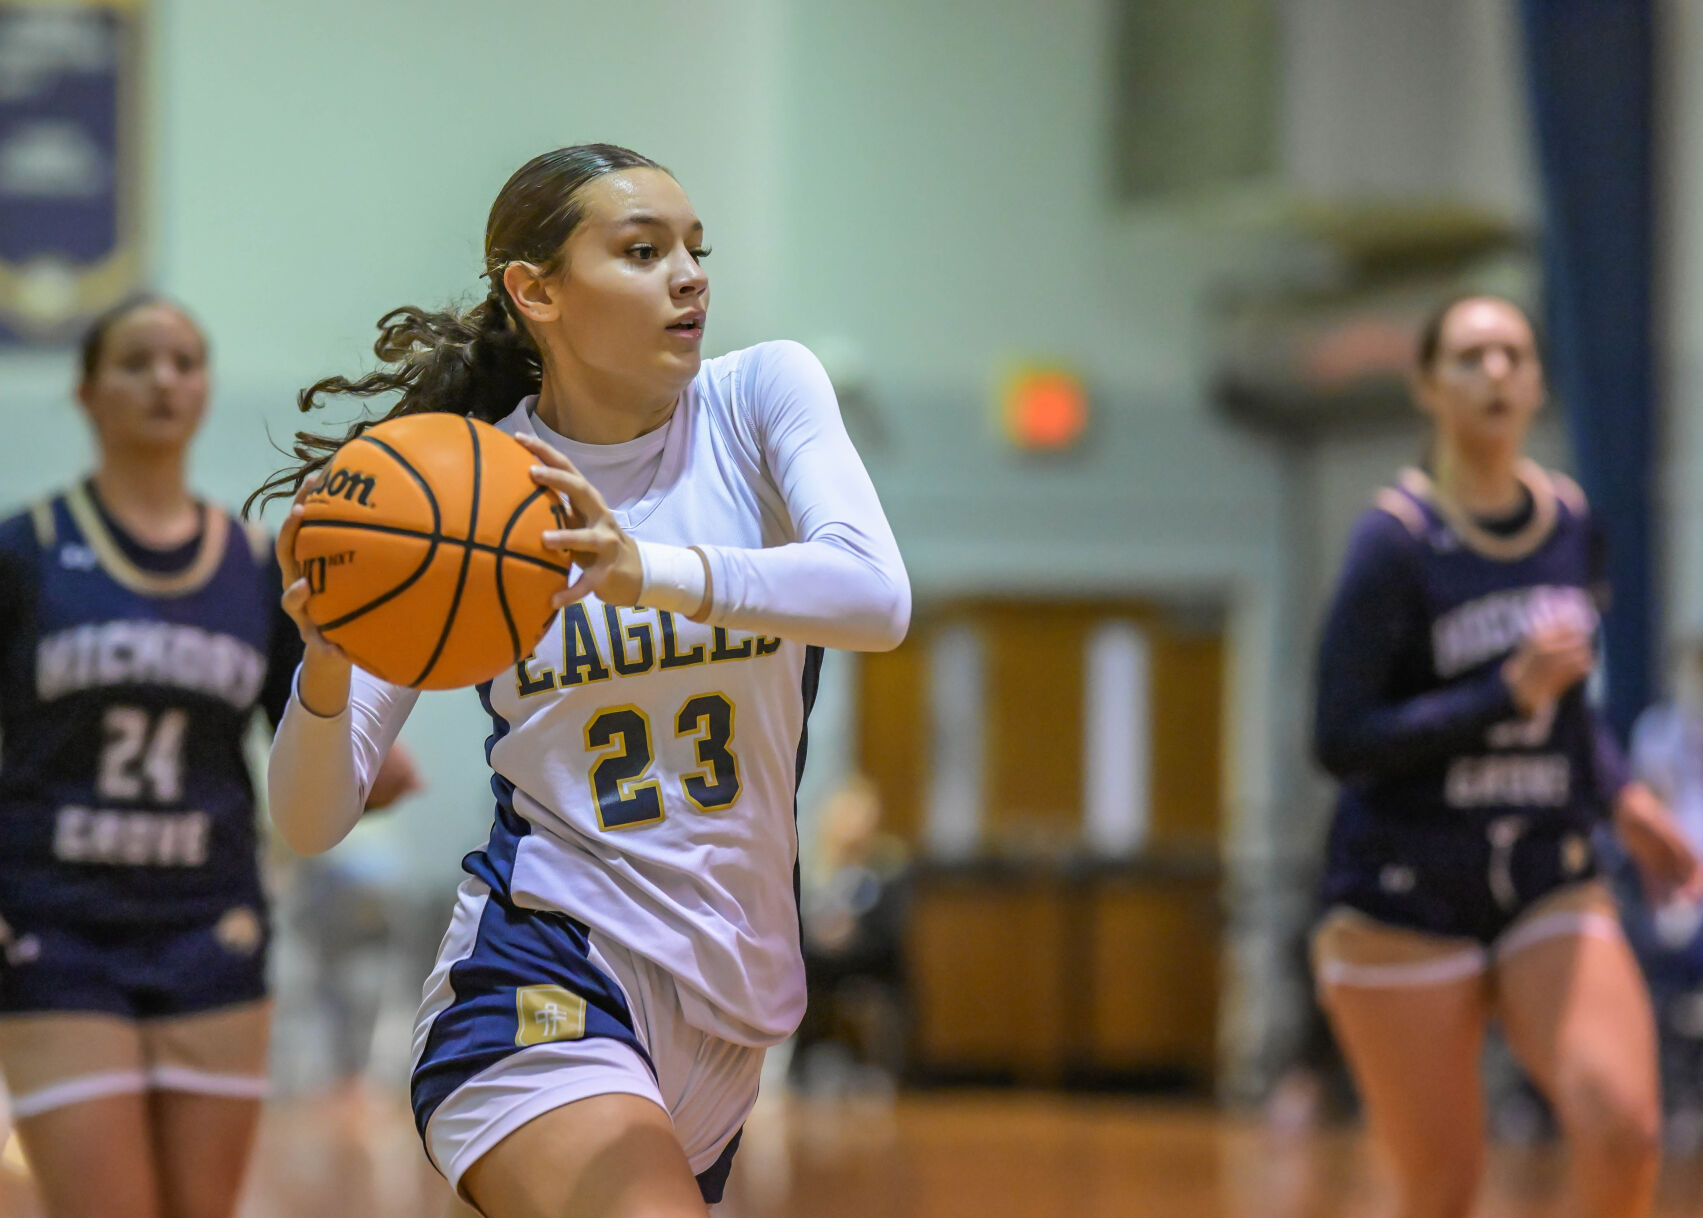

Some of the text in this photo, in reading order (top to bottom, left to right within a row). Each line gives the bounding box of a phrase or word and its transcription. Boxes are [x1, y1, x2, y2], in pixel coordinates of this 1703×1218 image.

[516, 600, 781, 698] EAGL
[99, 705, 189, 801] 24
[583, 691, 743, 832] 23
